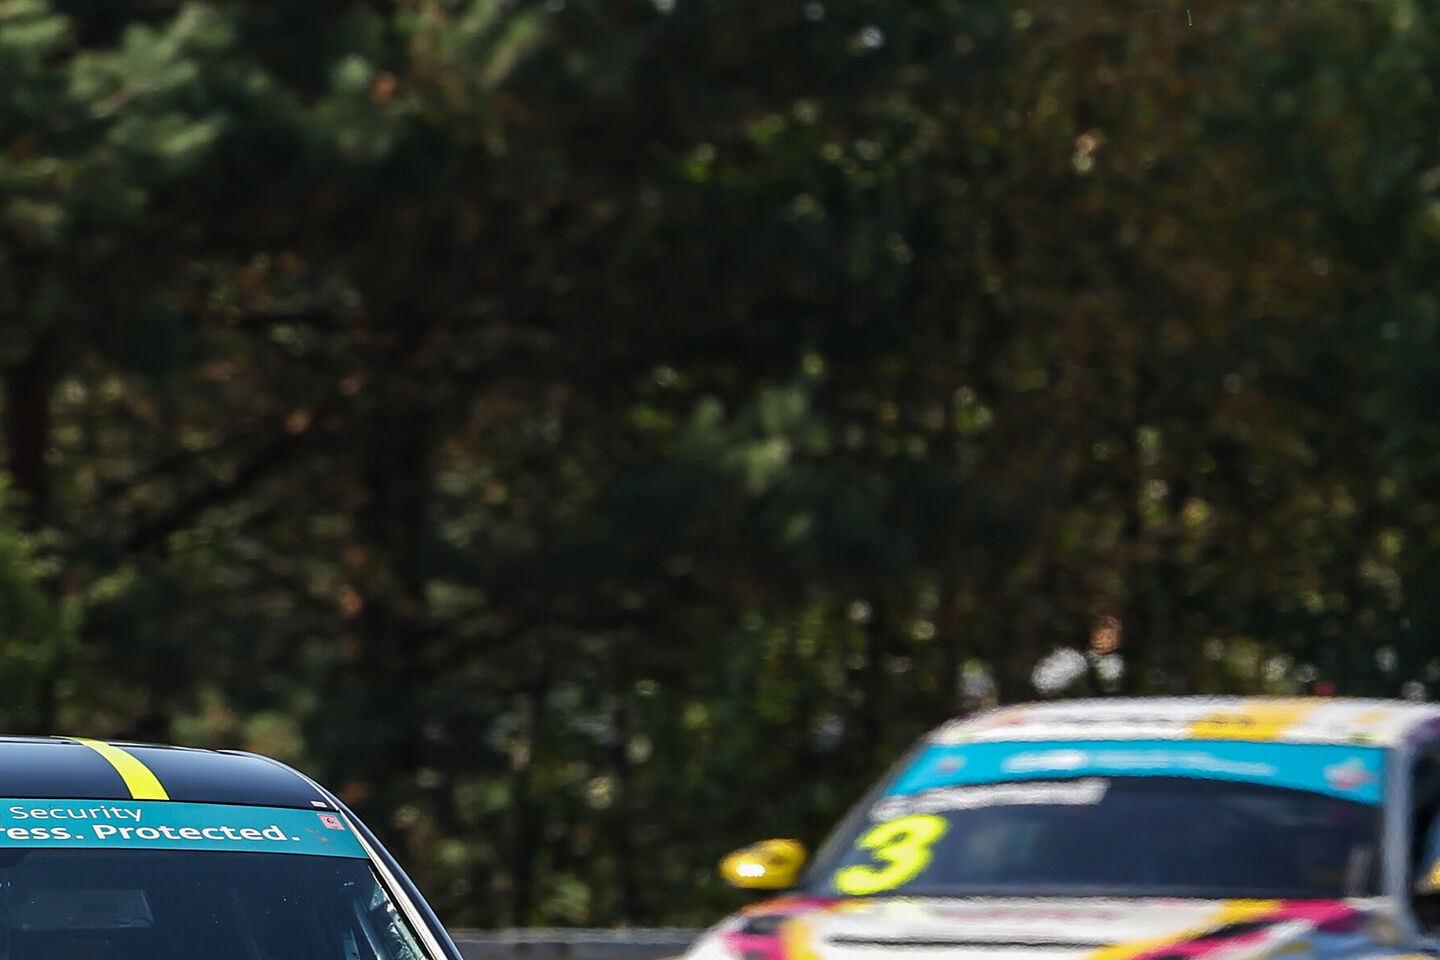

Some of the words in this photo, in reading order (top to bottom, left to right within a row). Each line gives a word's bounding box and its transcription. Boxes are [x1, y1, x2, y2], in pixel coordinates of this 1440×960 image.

[9, 805, 142, 822] Security
[92, 824, 301, 841] Protected.
[832, 813, 949, 894] 3
